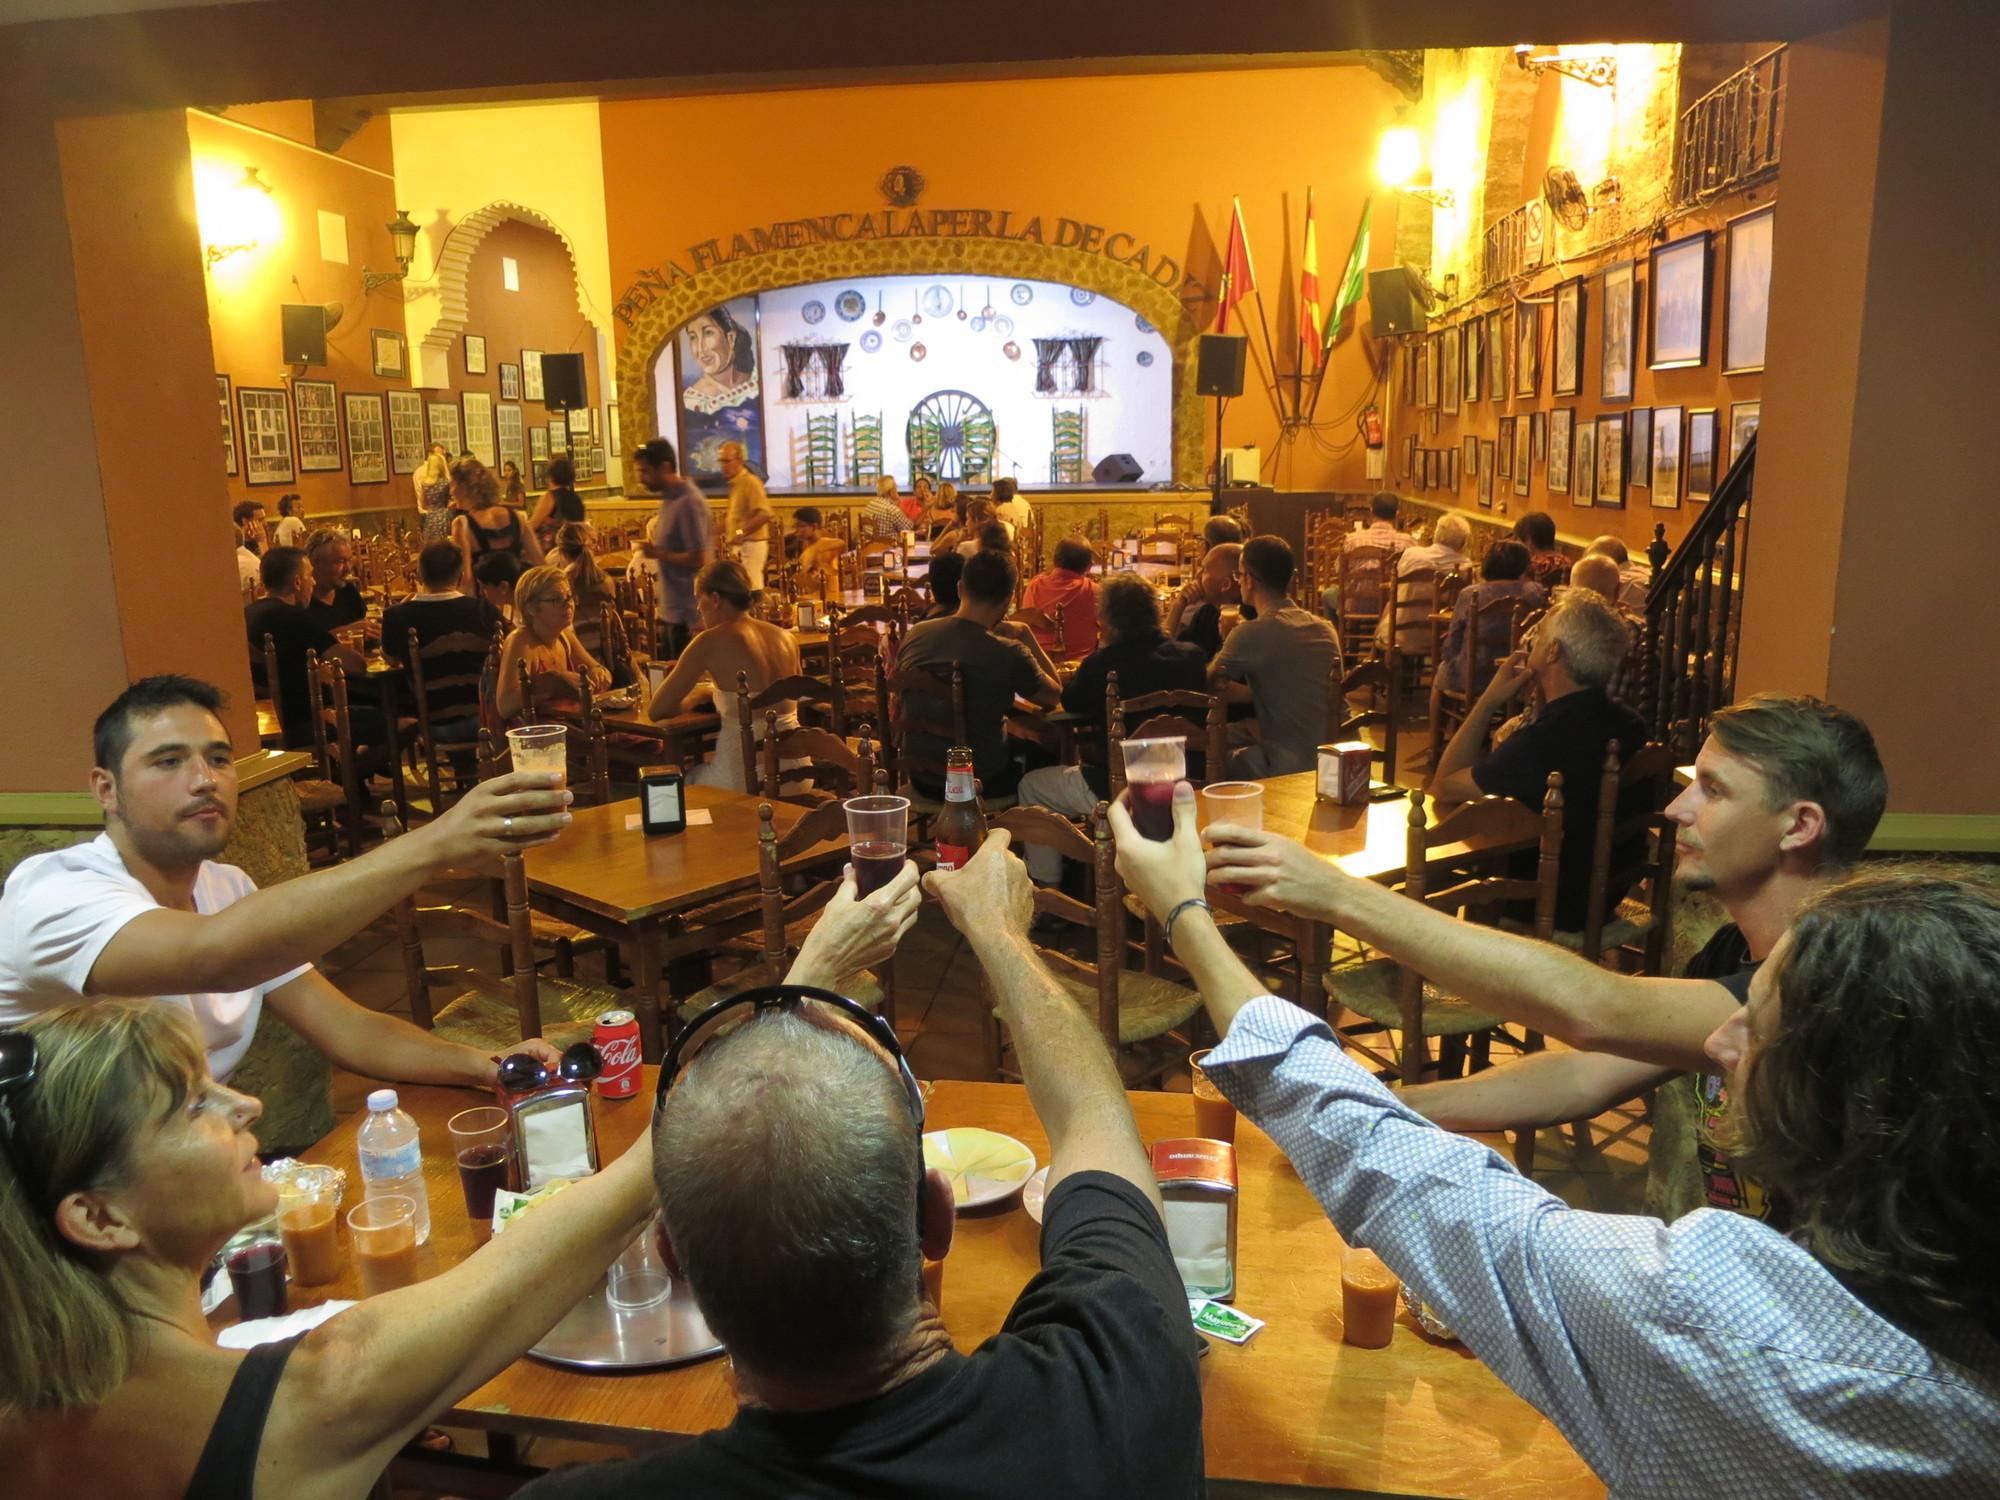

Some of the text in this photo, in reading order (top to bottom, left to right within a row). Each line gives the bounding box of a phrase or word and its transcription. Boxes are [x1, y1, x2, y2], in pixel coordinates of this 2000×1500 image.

[612, 260, 691, 328] PEÑA
[686, 212, 879, 273] FLAMENCA
[880, 209, 927, 239] LA
[926, 208, 1044, 246] PERLA
[1053, 217, 1105, 254] DE
[601, 1035, 638, 1066] Cola
